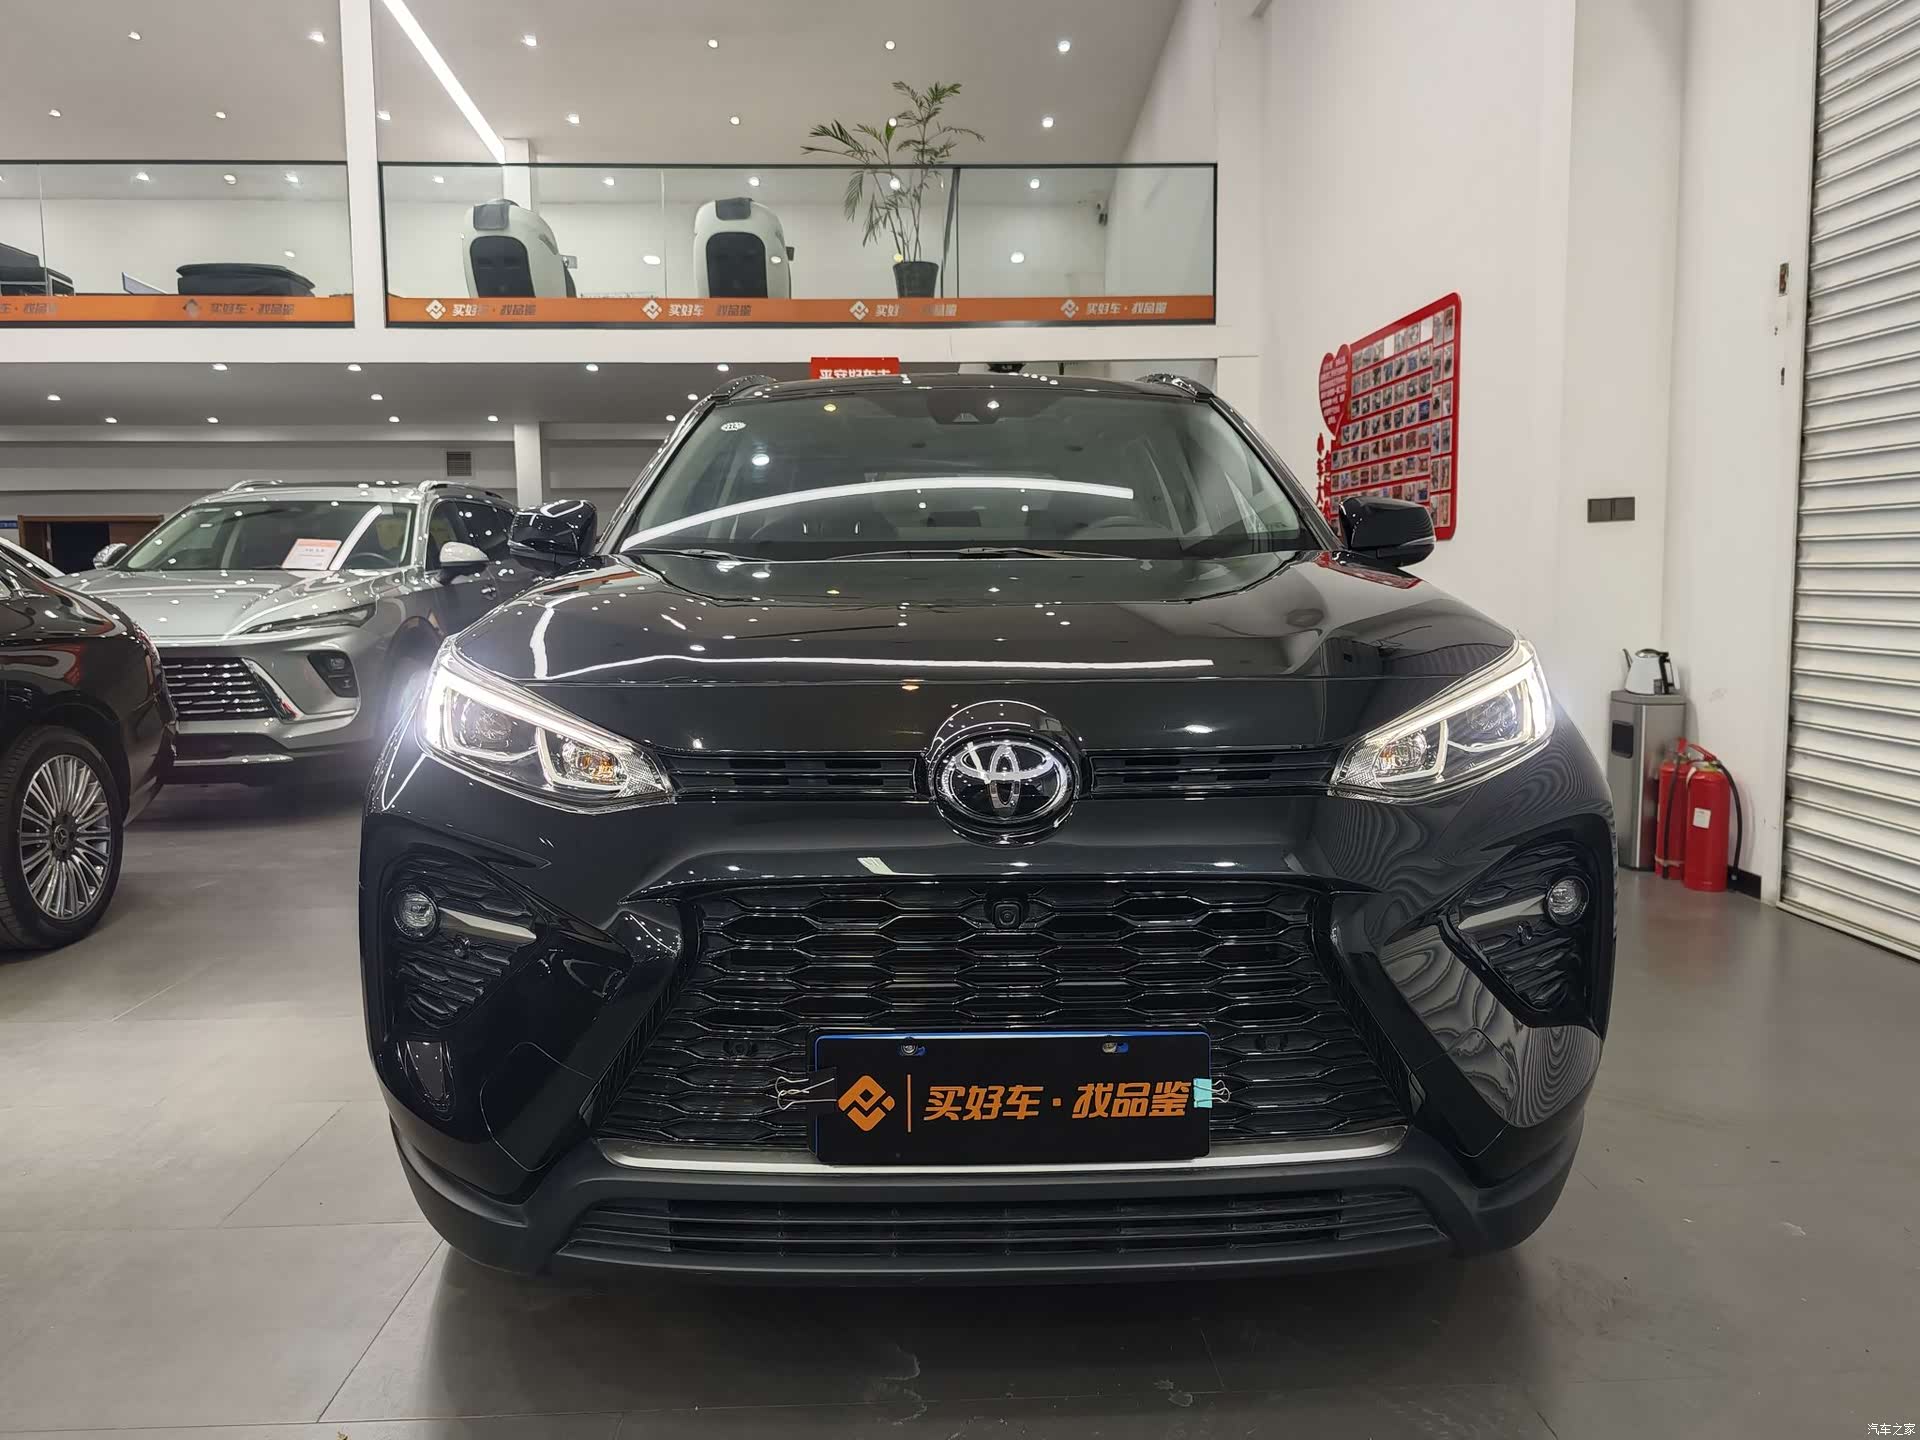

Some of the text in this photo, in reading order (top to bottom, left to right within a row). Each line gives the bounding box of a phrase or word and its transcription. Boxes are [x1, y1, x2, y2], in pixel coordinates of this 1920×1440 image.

[923, 1080, 1192, 1121] 买好车·找品鉴
